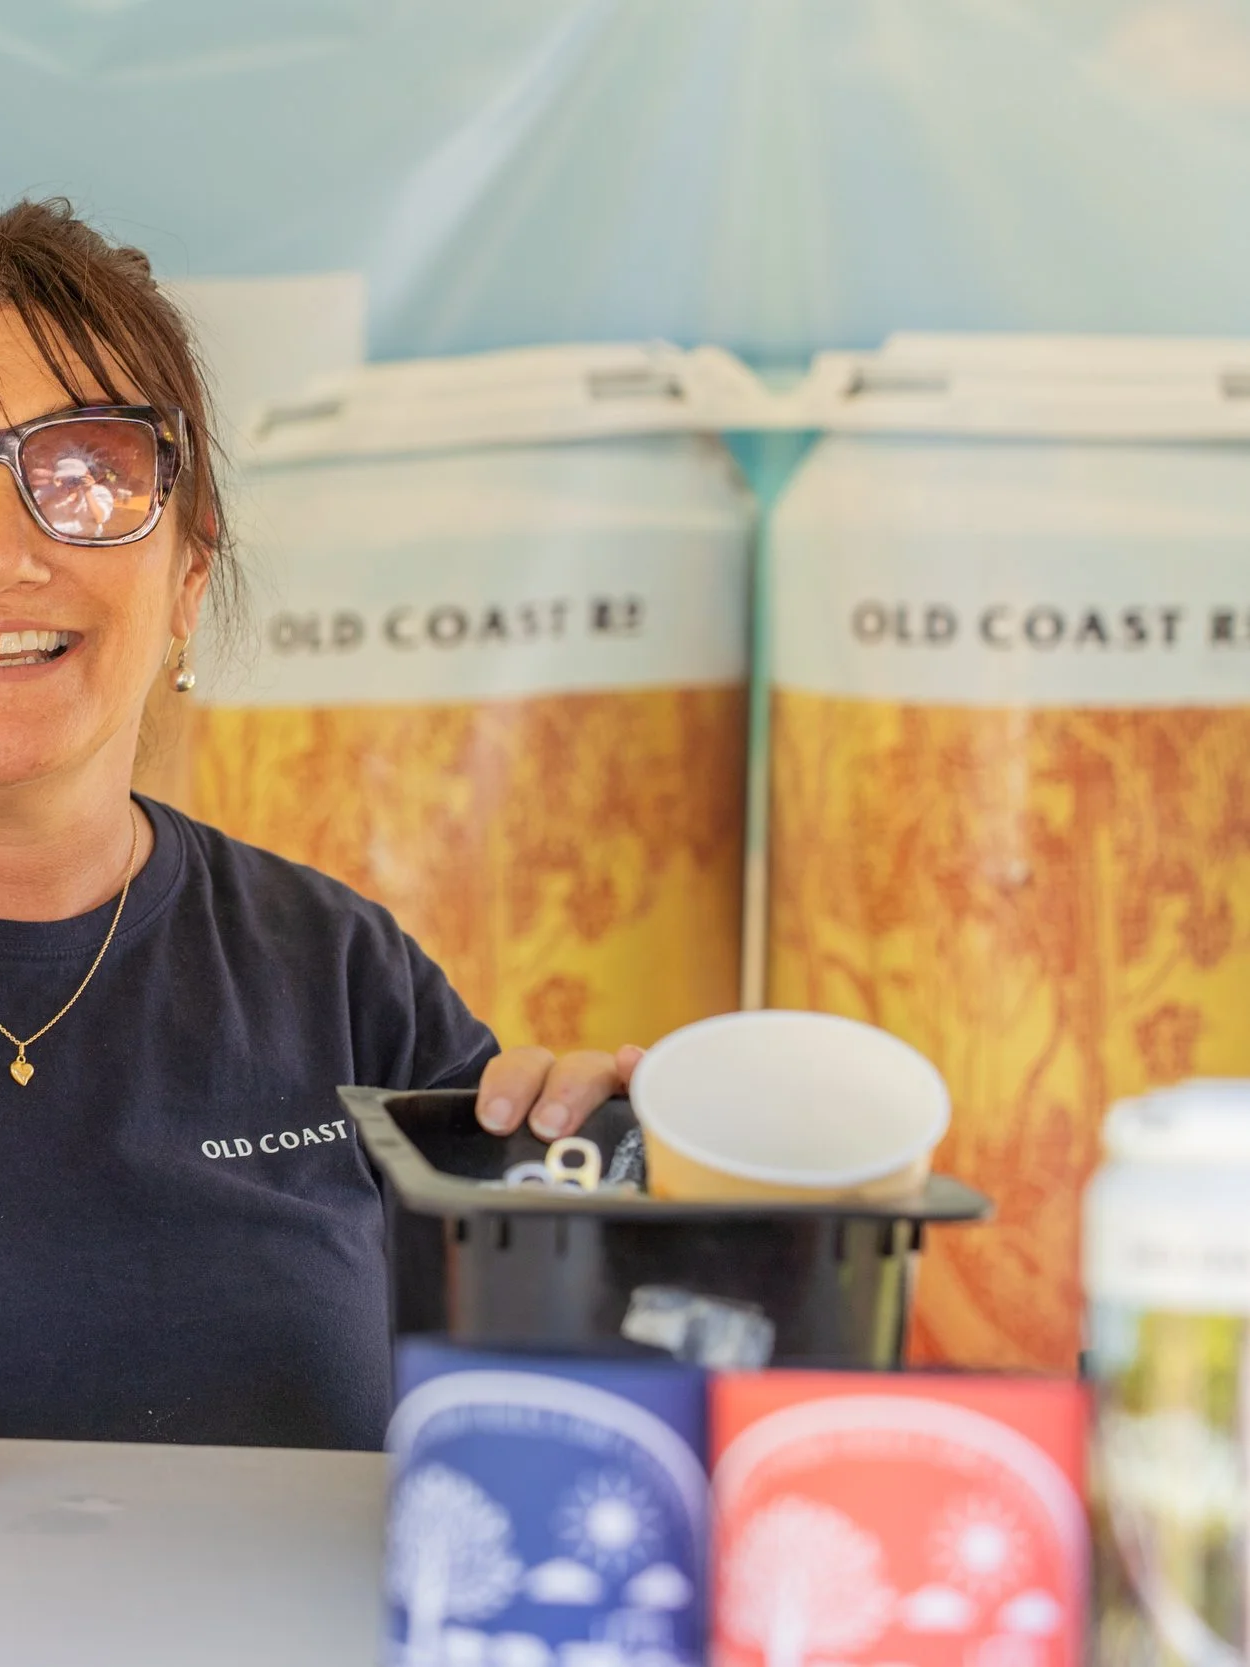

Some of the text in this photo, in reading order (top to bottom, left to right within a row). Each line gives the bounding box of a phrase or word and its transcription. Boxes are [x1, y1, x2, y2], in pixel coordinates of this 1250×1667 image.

[268, 608, 365, 654] OLD
[384, 598, 569, 651] COAST
[852, 599, 957, 649] OLD
[978, 604, 1183, 652] COAST
[201, 1119, 348, 1159] OLD COAST
